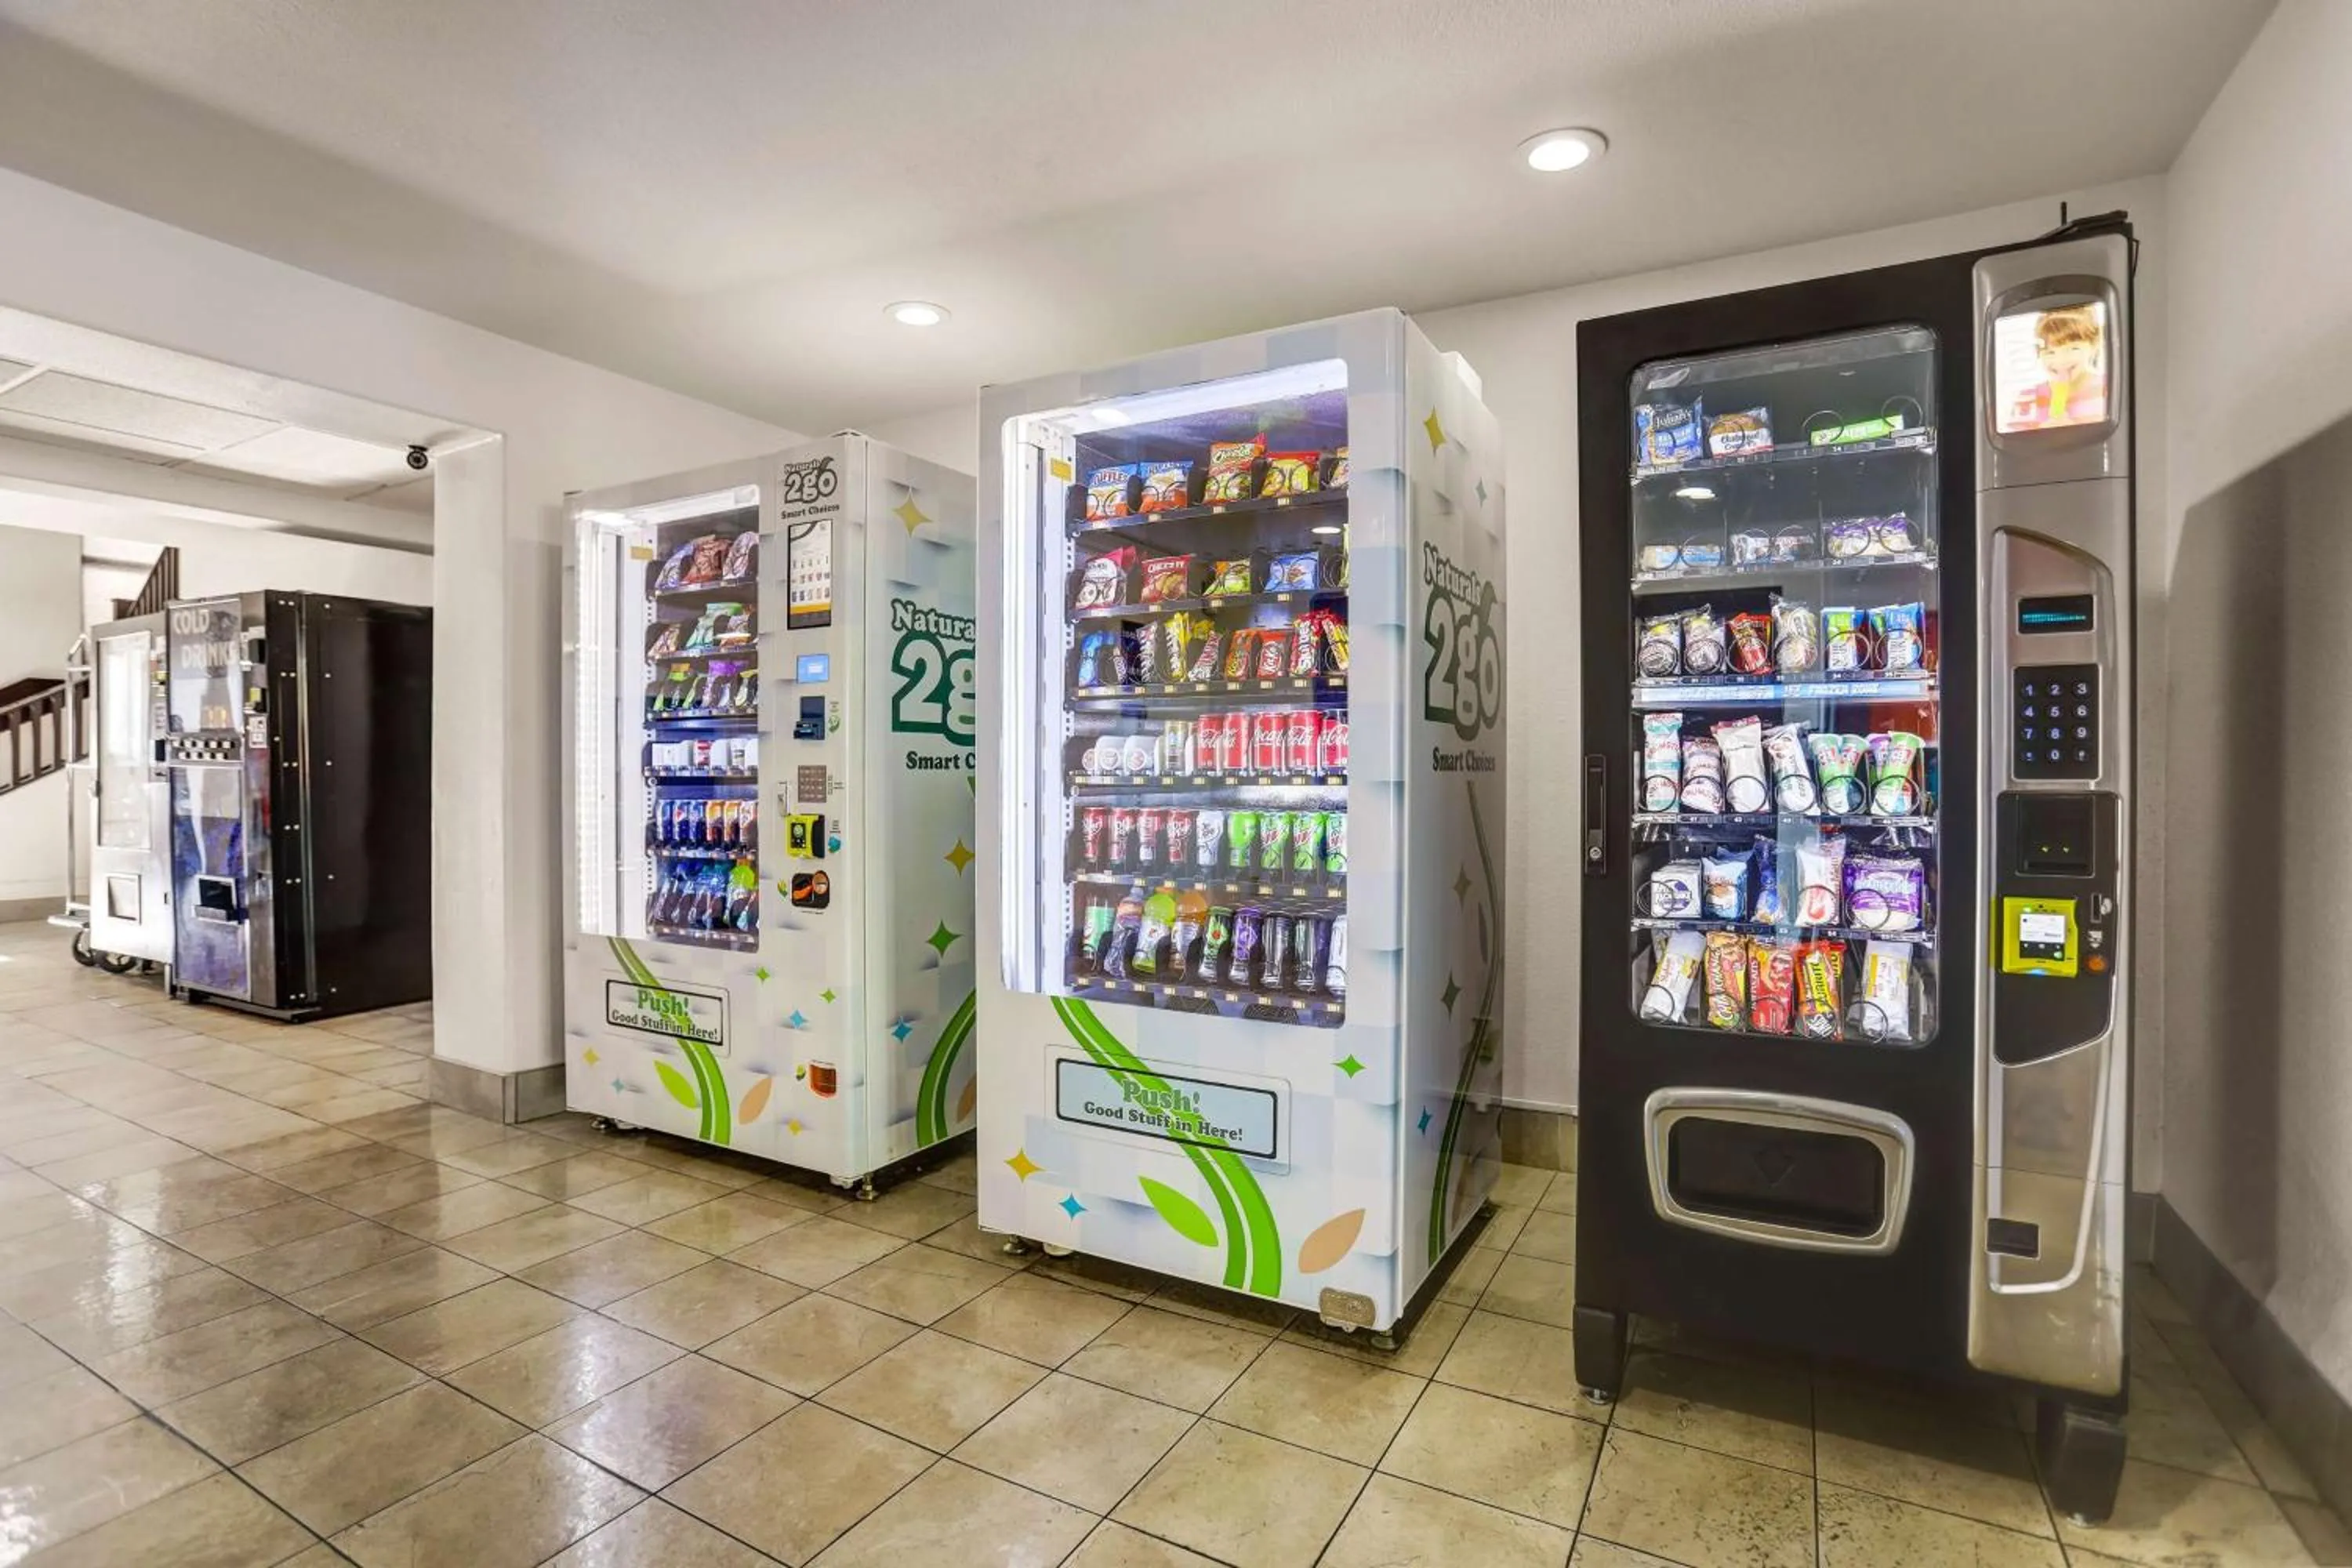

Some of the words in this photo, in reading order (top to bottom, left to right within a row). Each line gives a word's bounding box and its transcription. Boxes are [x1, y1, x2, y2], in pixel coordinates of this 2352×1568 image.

[175, 609, 209, 635] COLD
[891, 598, 975, 642] Natura
[181, 641, 235, 670] DRINKS
[1425, 588, 1501, 742] 2go
[891, 629, 975, 746] 2g
[2025, 684, 2034, 696] 1
[2051, 684, 2060, 695] 2
[2078, 683, 2087, 695] 3
[2024, 706, 2034, 717] 4
[2051, 706, 2060, 717] 5
[2078, 706, 2086, 717] 6
[2024, 728, 2033, 739] 7
[2051, 728, 2060, 739] 8
[2078, 727, 2086, 739] 9
[906, 750, 960, 770] Smart
[1432, 746, 1463, 772] Smart
[2051, 749, 2060, 760] 0
[637, 989, 689, 1017] Push!
[612, 1009, 638, 1025] Good
[688, 1023, 717, 1040] Here!
[1123, 1079, 1200, 1113] Push!
[1083, 1101, 1123, 1120] Good
[1128, 1109, 1171, 1127] Stuff
[1175, 1117, 1192, 1132] in
[1198, 1120, 1243, 1141] Here!
